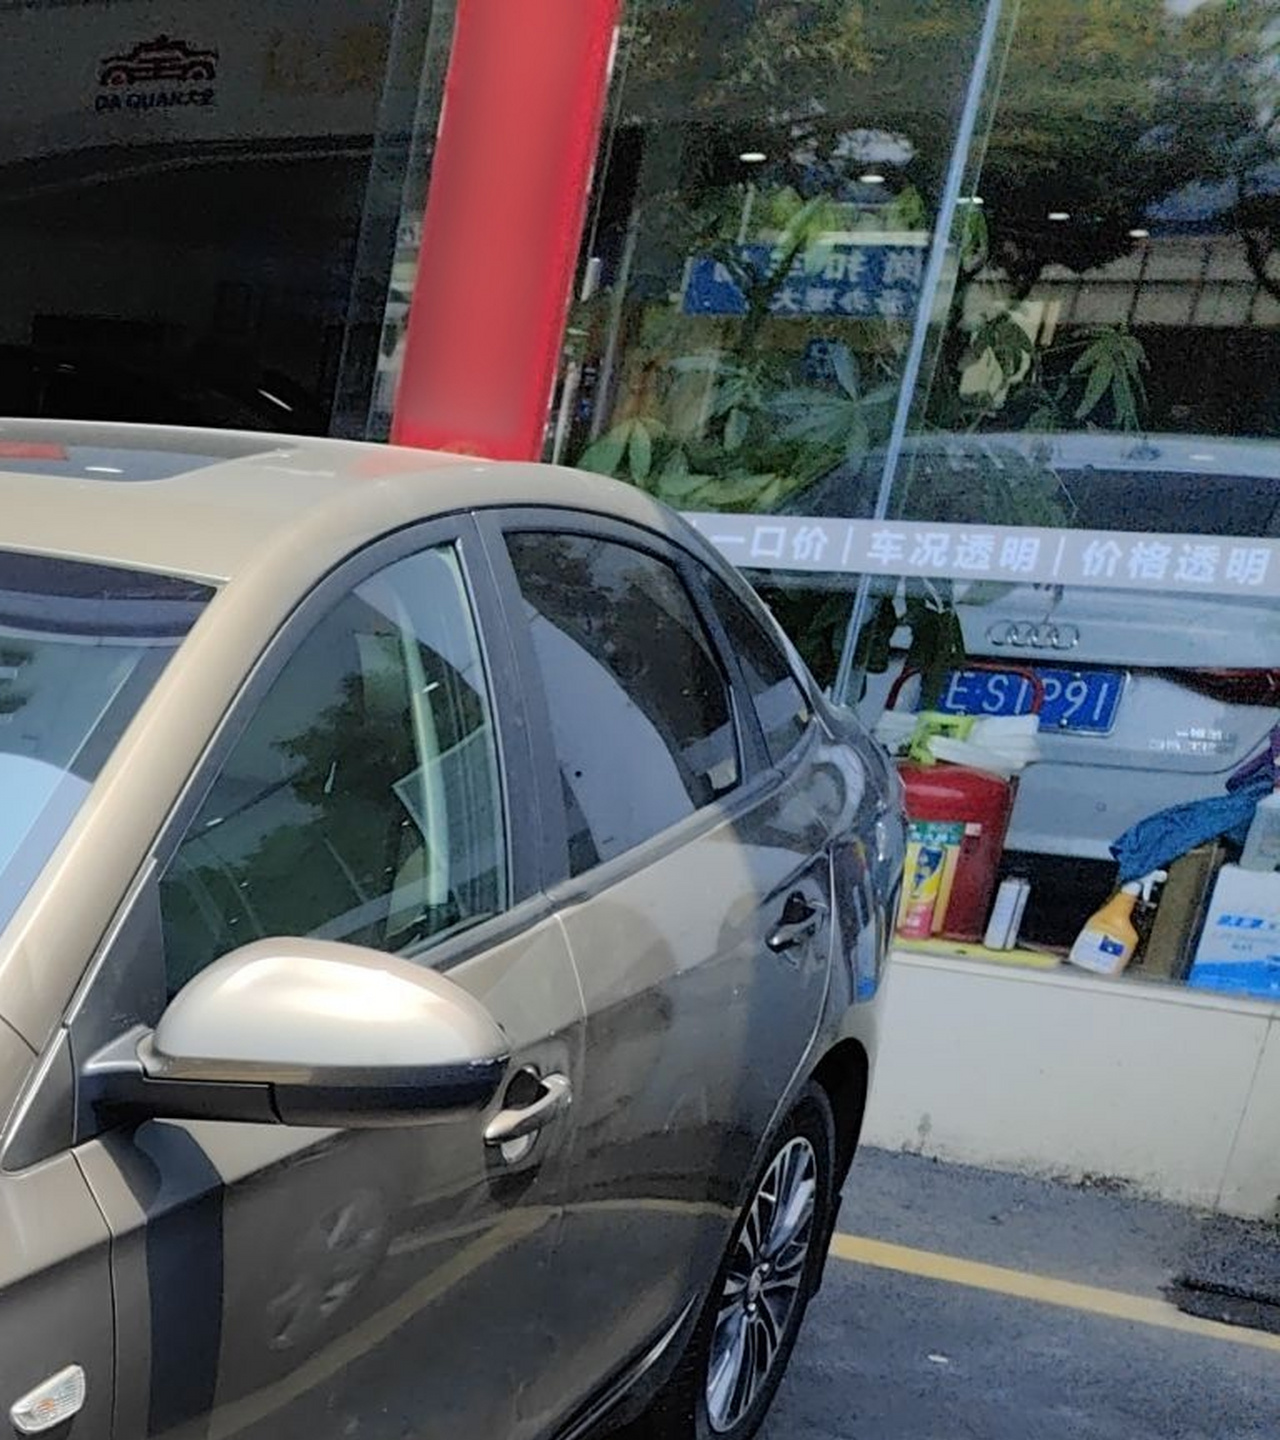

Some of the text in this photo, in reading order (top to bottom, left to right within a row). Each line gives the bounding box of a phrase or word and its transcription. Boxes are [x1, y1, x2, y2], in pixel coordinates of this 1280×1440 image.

[711, 525, 1271, 587] 一口价 车况透明 价格透明
[943, 670, 1109, 722] E·S1P91
